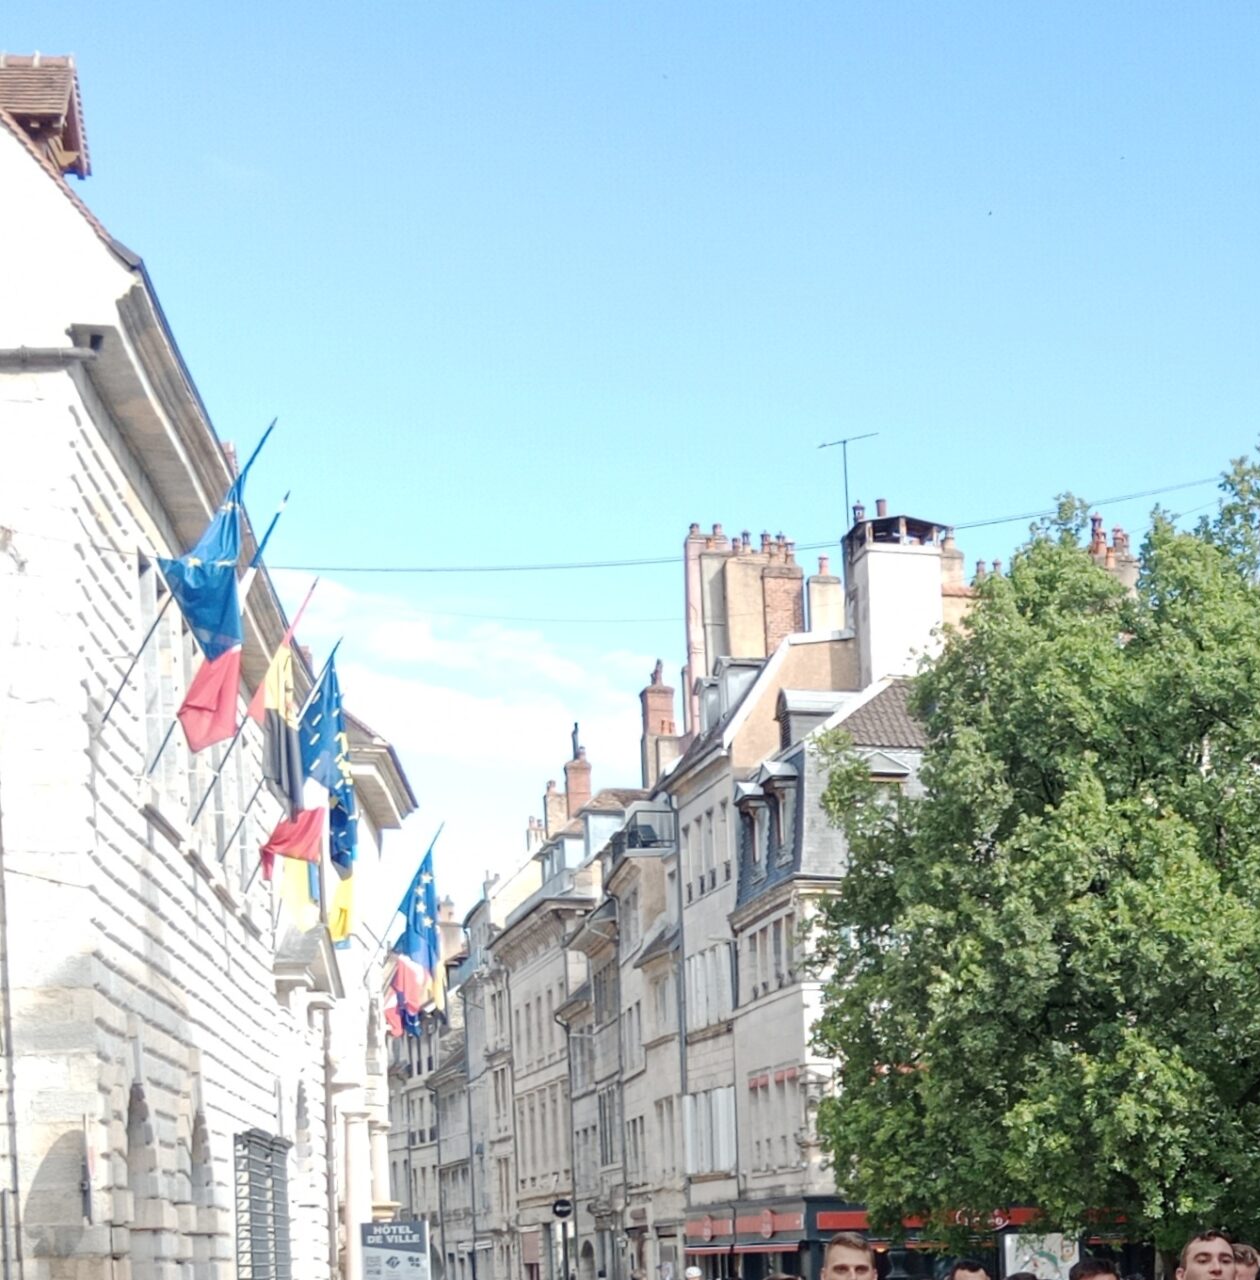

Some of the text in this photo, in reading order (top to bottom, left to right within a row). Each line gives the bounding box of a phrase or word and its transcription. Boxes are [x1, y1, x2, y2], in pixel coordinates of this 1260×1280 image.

[373, 1223, 413, 1235] HÔTEL
[367, 1234, 420, 1244] DE VILLE
